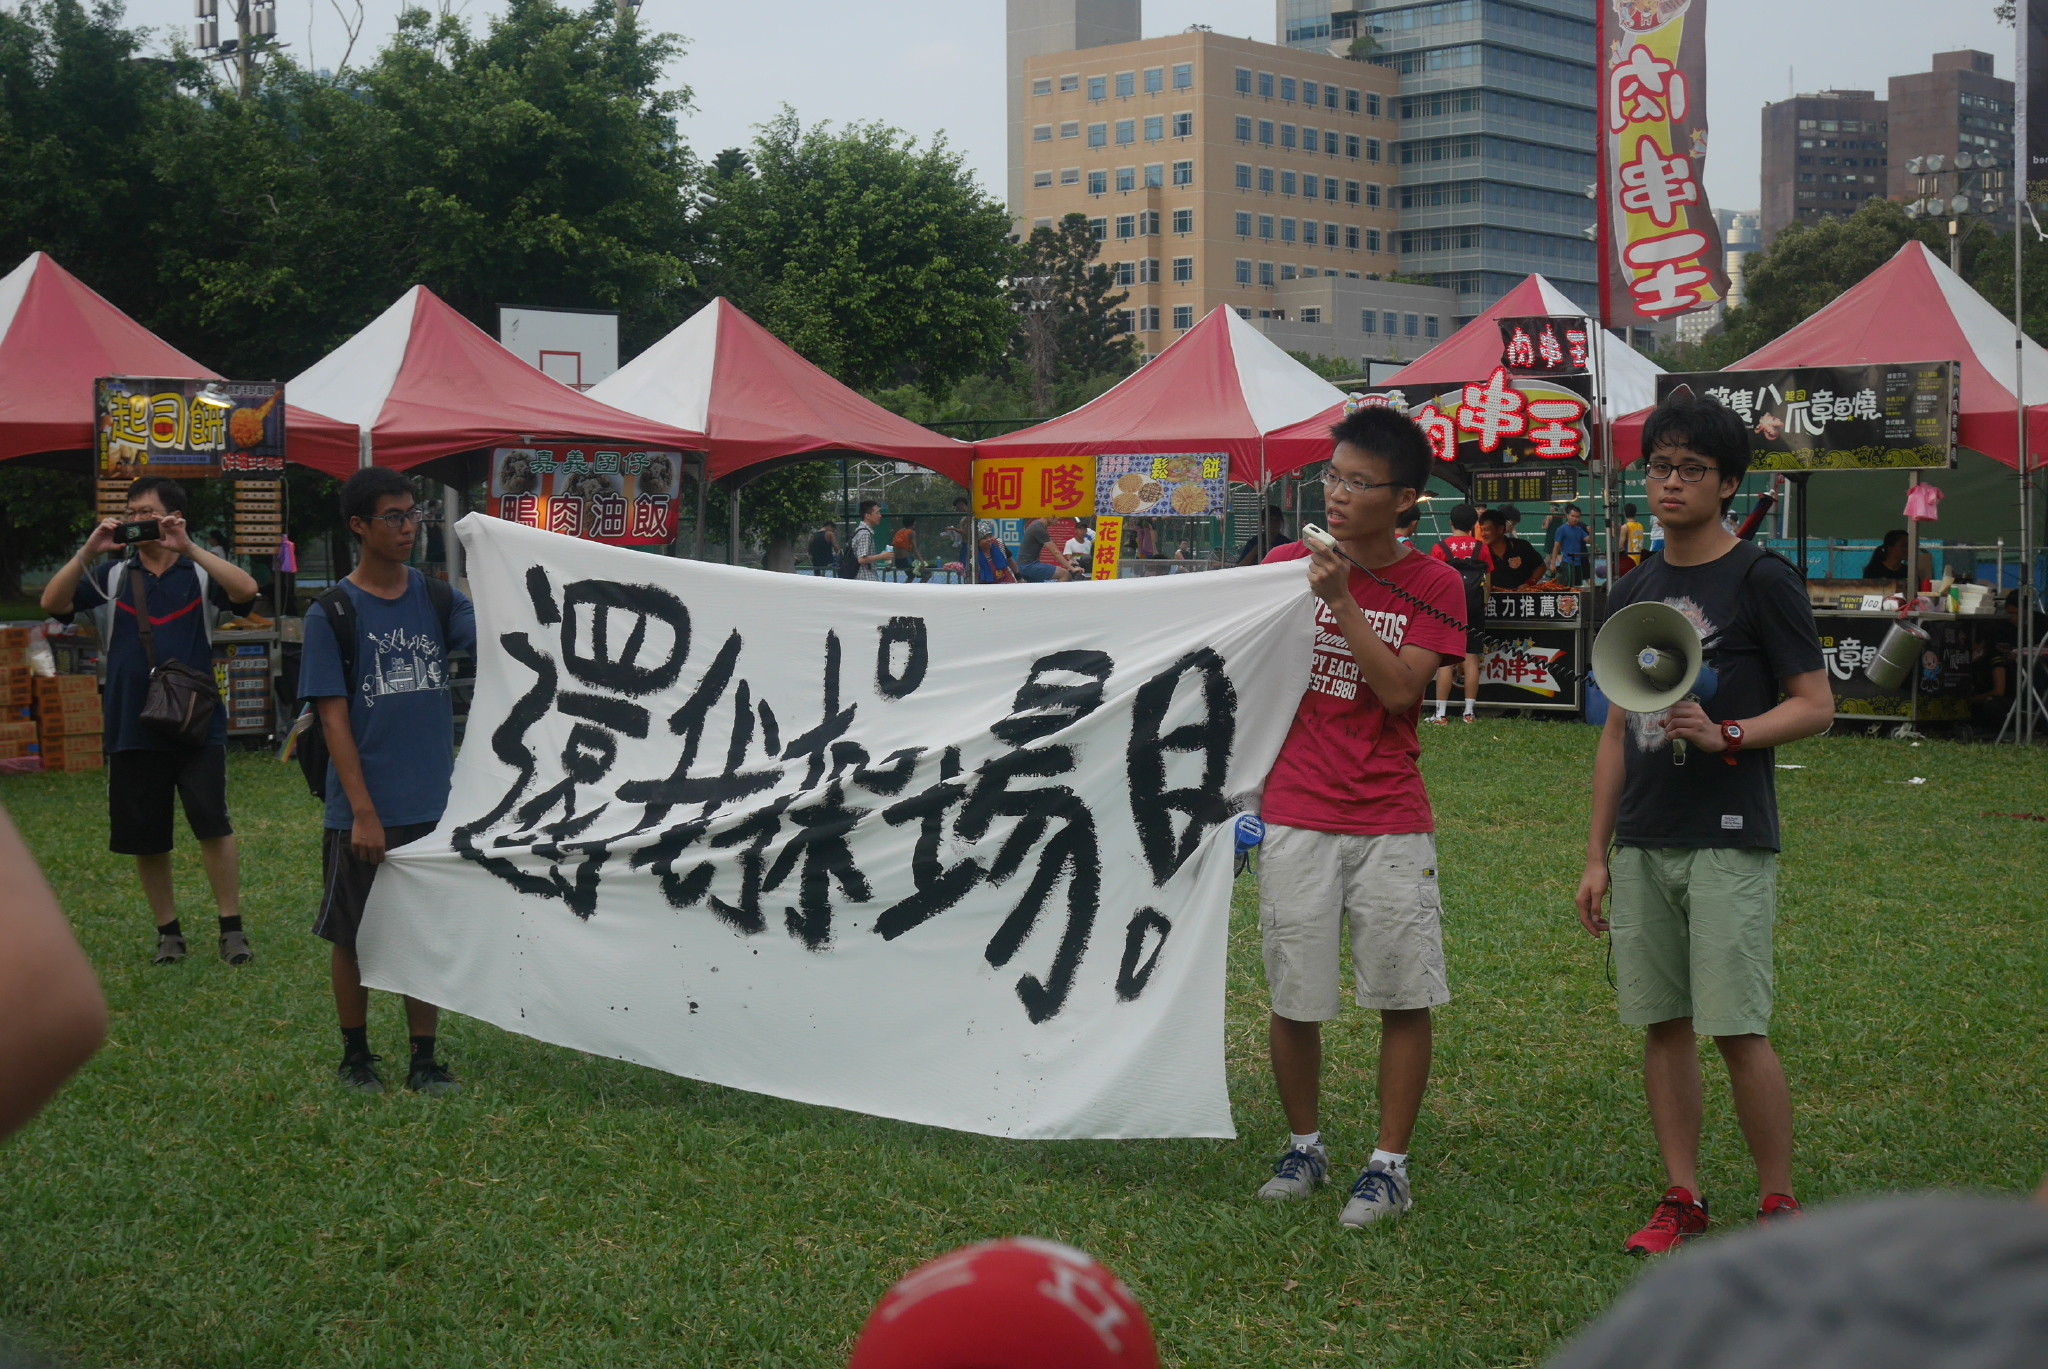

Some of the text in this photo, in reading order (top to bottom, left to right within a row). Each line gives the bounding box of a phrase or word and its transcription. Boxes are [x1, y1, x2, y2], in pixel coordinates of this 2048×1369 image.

[1507, 324, 1587, 368] 肉串王
[1784, 389, 1806, 402] 起司
[111, 391, 226, 451] 起司餅
[1202, 457, 1221, 480] 餅
[981, 463, 1085, 511] 蚵嗲
[500, 491, 671, 538] 鴨肉油飯
[1095, 520, 1119, 580] 花枝丸
[1485, 595, 1556, 618] 強力推薦
[1864, 599, 1879, 609] 100
[1328, 657, 1360, 682] EACH
[1486, 652, 1550, 684] 肉串王
